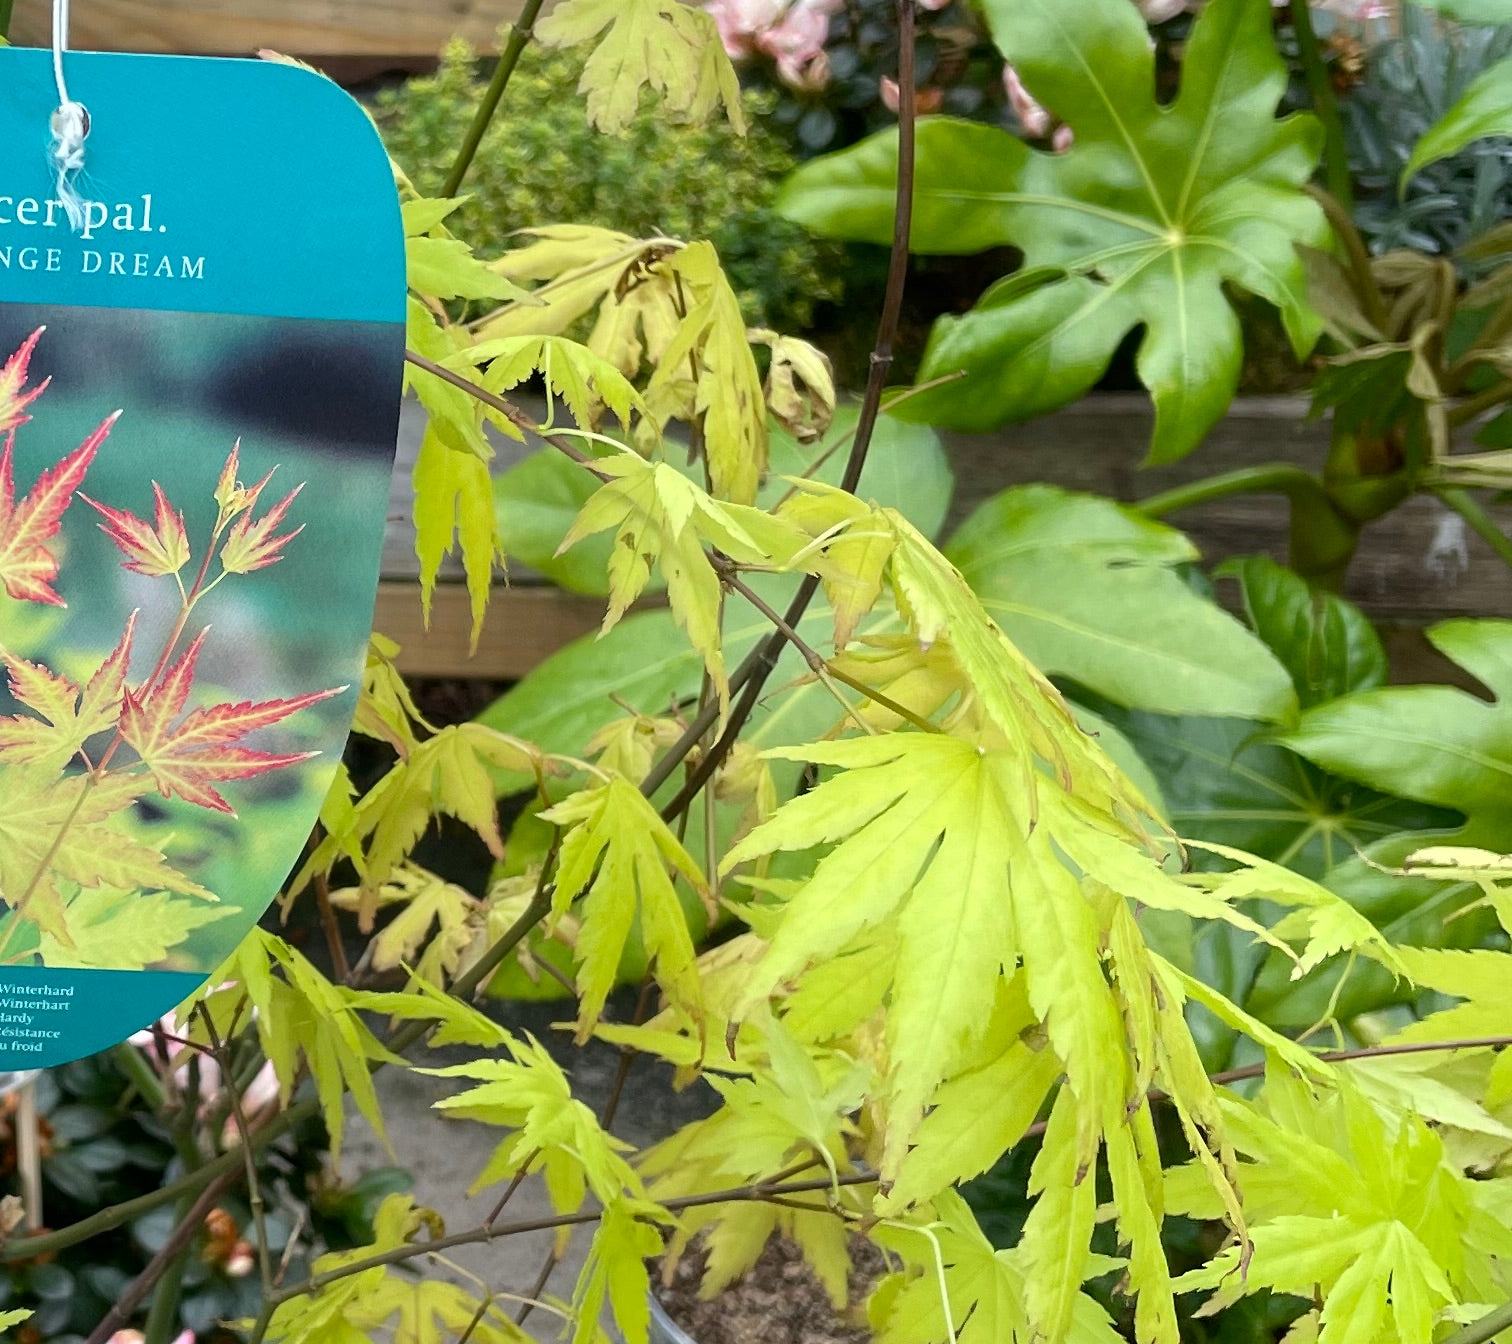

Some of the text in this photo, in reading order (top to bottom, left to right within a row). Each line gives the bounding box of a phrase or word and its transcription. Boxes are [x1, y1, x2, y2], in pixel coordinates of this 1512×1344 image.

[80, 193, 168, 240] pal.
[81, 249, 207, 280] DREAM
[11, 1040, 43, 1052] froid
